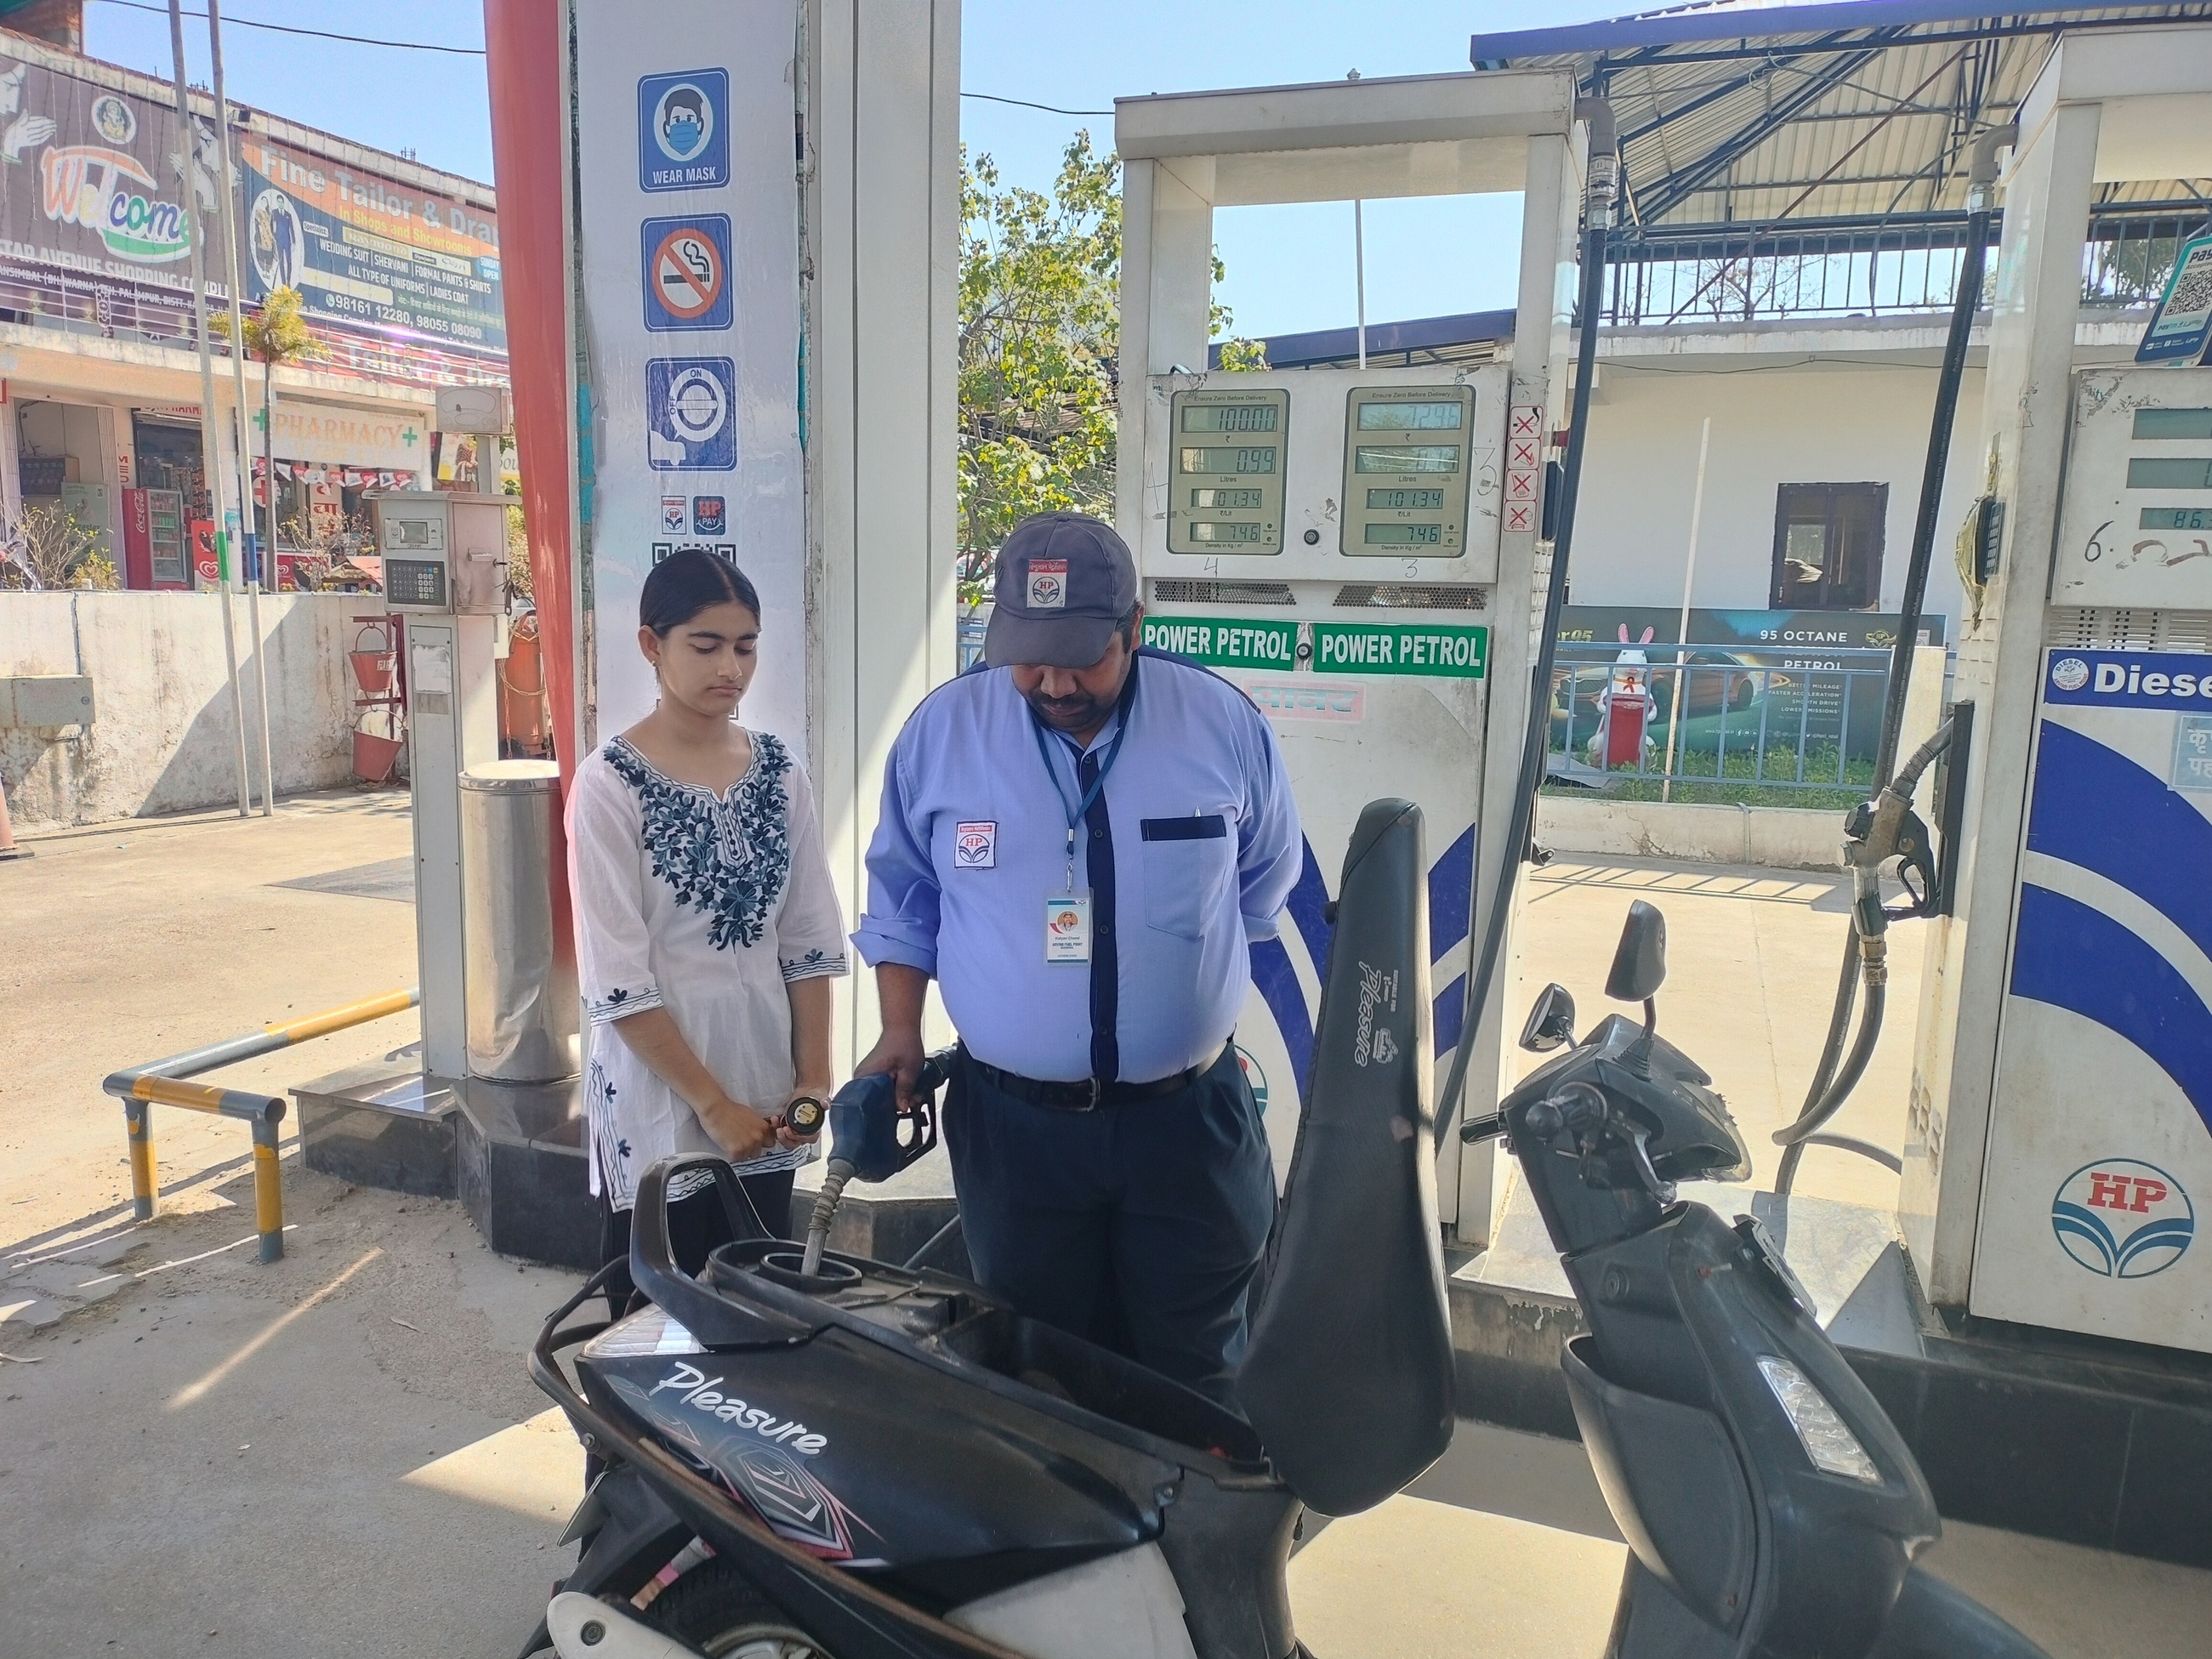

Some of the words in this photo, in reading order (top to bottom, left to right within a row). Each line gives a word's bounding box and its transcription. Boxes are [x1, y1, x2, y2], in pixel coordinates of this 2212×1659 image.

[652, 169, 683, 185] WEAR
[685, 166, 716, 182] MASK
[260, 145, 326, 193] Fine
[335, 172, 413, 220] Tailor
[421, 201, 441, 229] &
[353, 209, 387, 232] Shops
[390, 224, 410, 239] and
[412, 227, 473, 255] Showrooms
[320, 238, 352, 259] WEDDING
[354, 249, 370, 264] SUIT
[374, 255, 408, 274] SHERVANI
[415, 264, 441, 282] FORMAL
[442, 272, 463, 287] PANTS
[469, 279, 492, 294] SHIRTS
[483, 269, 499, 281] OPEN
[348, 264, 361, 278] ALL
[362, 268, 380, 283] TYPE
[380, 274, 390, 286] OF
[391, 276, 425, 294] UNIFORMS
[429, 285, 452, 301] LADIES
[452, 291, 469, 305] COAT
[335, 294, 371, 315] 98161
[375, 304, 413, 328] 12280,
[416, 315, 449, 332] 98055
[452, 322, 482, 339] 08090
[690, 369, 702, 378] ON
[1219, 408, 1276, 431] 100.00
[274, 413, 403, 449] PHARMACY
[1236, 450, 1275, 473] 0.99
[698, 501, 721, 516] HP
[1388, 492, 1441, 507] 101.34
[702, 517, 717, 526] PAY
[1230, 526, 1258, 541] 746
[1407, 527, 1438, 543] 746
[1204, 557, 1218, 578] 4
[1402, 558, 1418, 578] 3
[1039, 581, 1054, 589] HP
[1145, 624, 1211, 656] POWER
[1216, 628, 1292, 661] PETROL
[1760, 629, 1777, 640] 95
[1783, 630, 1848, 643] OCTANE
[1322, 633, 1393, 664] POWER
[1399, 635, 1481, 667] PETROL
[2056, 659, 2083, 672] DIESEL
[1355, 961, 1382, 1067] Pleasure
[2087, 1172, 2167, 1213] HP
[648, 1361, 828, 1455] Pleasure
